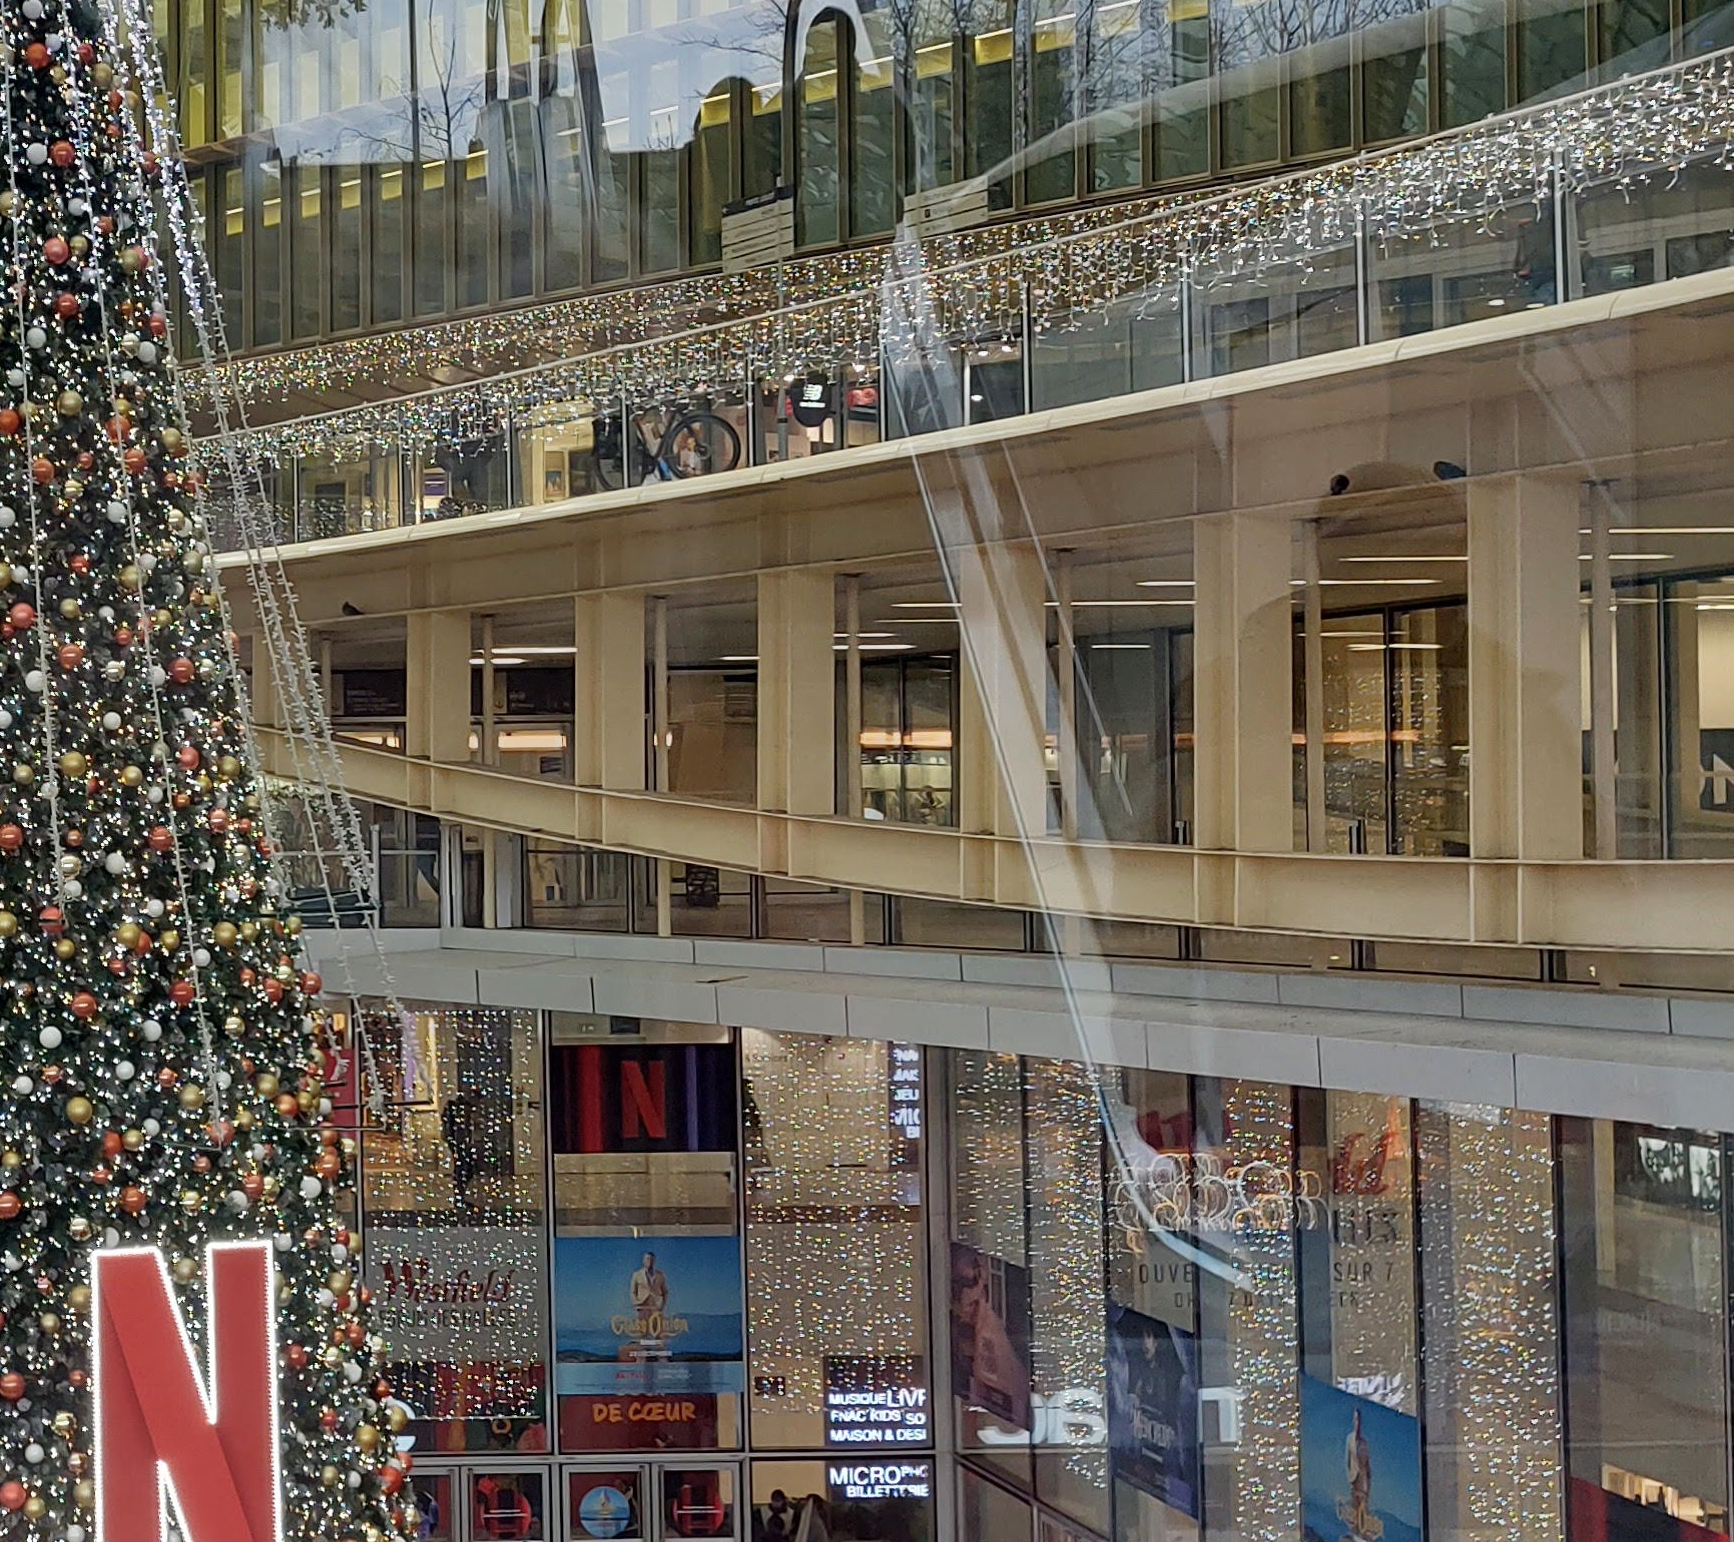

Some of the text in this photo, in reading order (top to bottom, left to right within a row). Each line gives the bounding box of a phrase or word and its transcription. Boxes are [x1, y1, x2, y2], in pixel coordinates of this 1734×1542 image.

[620, 1060, 666, 1139] N
[1139, 1262, 1192, 1284] OUVE
[828, 1392, 886, 1405] MUSIQUE
[592, 1402, 696, 1423] DE CŒUR
[830, 1409, 866, 1422] FNAC
[869, 1408, 901, 1422] KIDS
[830, 1429, 882, 1442] MAISON
[884, 1429, 894, 1441] &
[829, 1466, 901, 1485] MICRO
